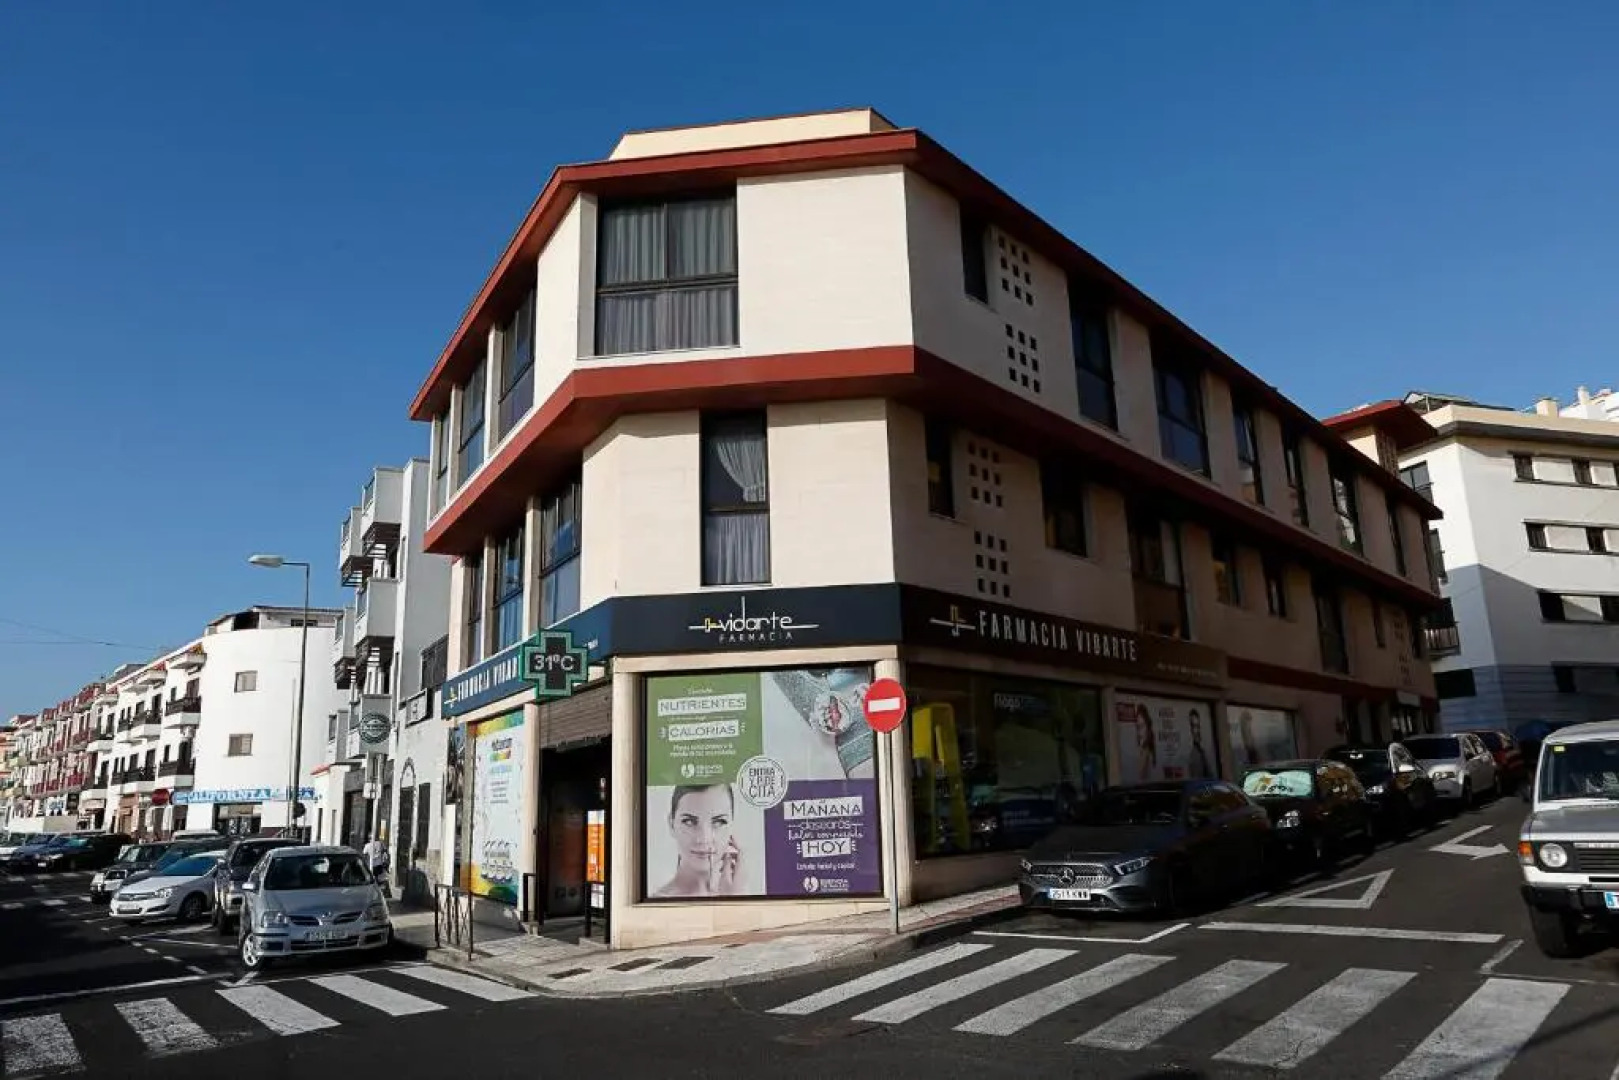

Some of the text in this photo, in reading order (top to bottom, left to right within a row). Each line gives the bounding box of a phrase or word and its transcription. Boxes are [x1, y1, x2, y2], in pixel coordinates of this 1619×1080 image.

[719, 596, 793, 632] vidarte
[719, 631, 793, 643] FARMACIA
[978, 609, 1137, 662] FARMACIA VIDARTE
[660, 699, 746, 712] NUTRIENTES
[748, 785, 776, 799] CITA
[807, 840, 846, 854] HOY
